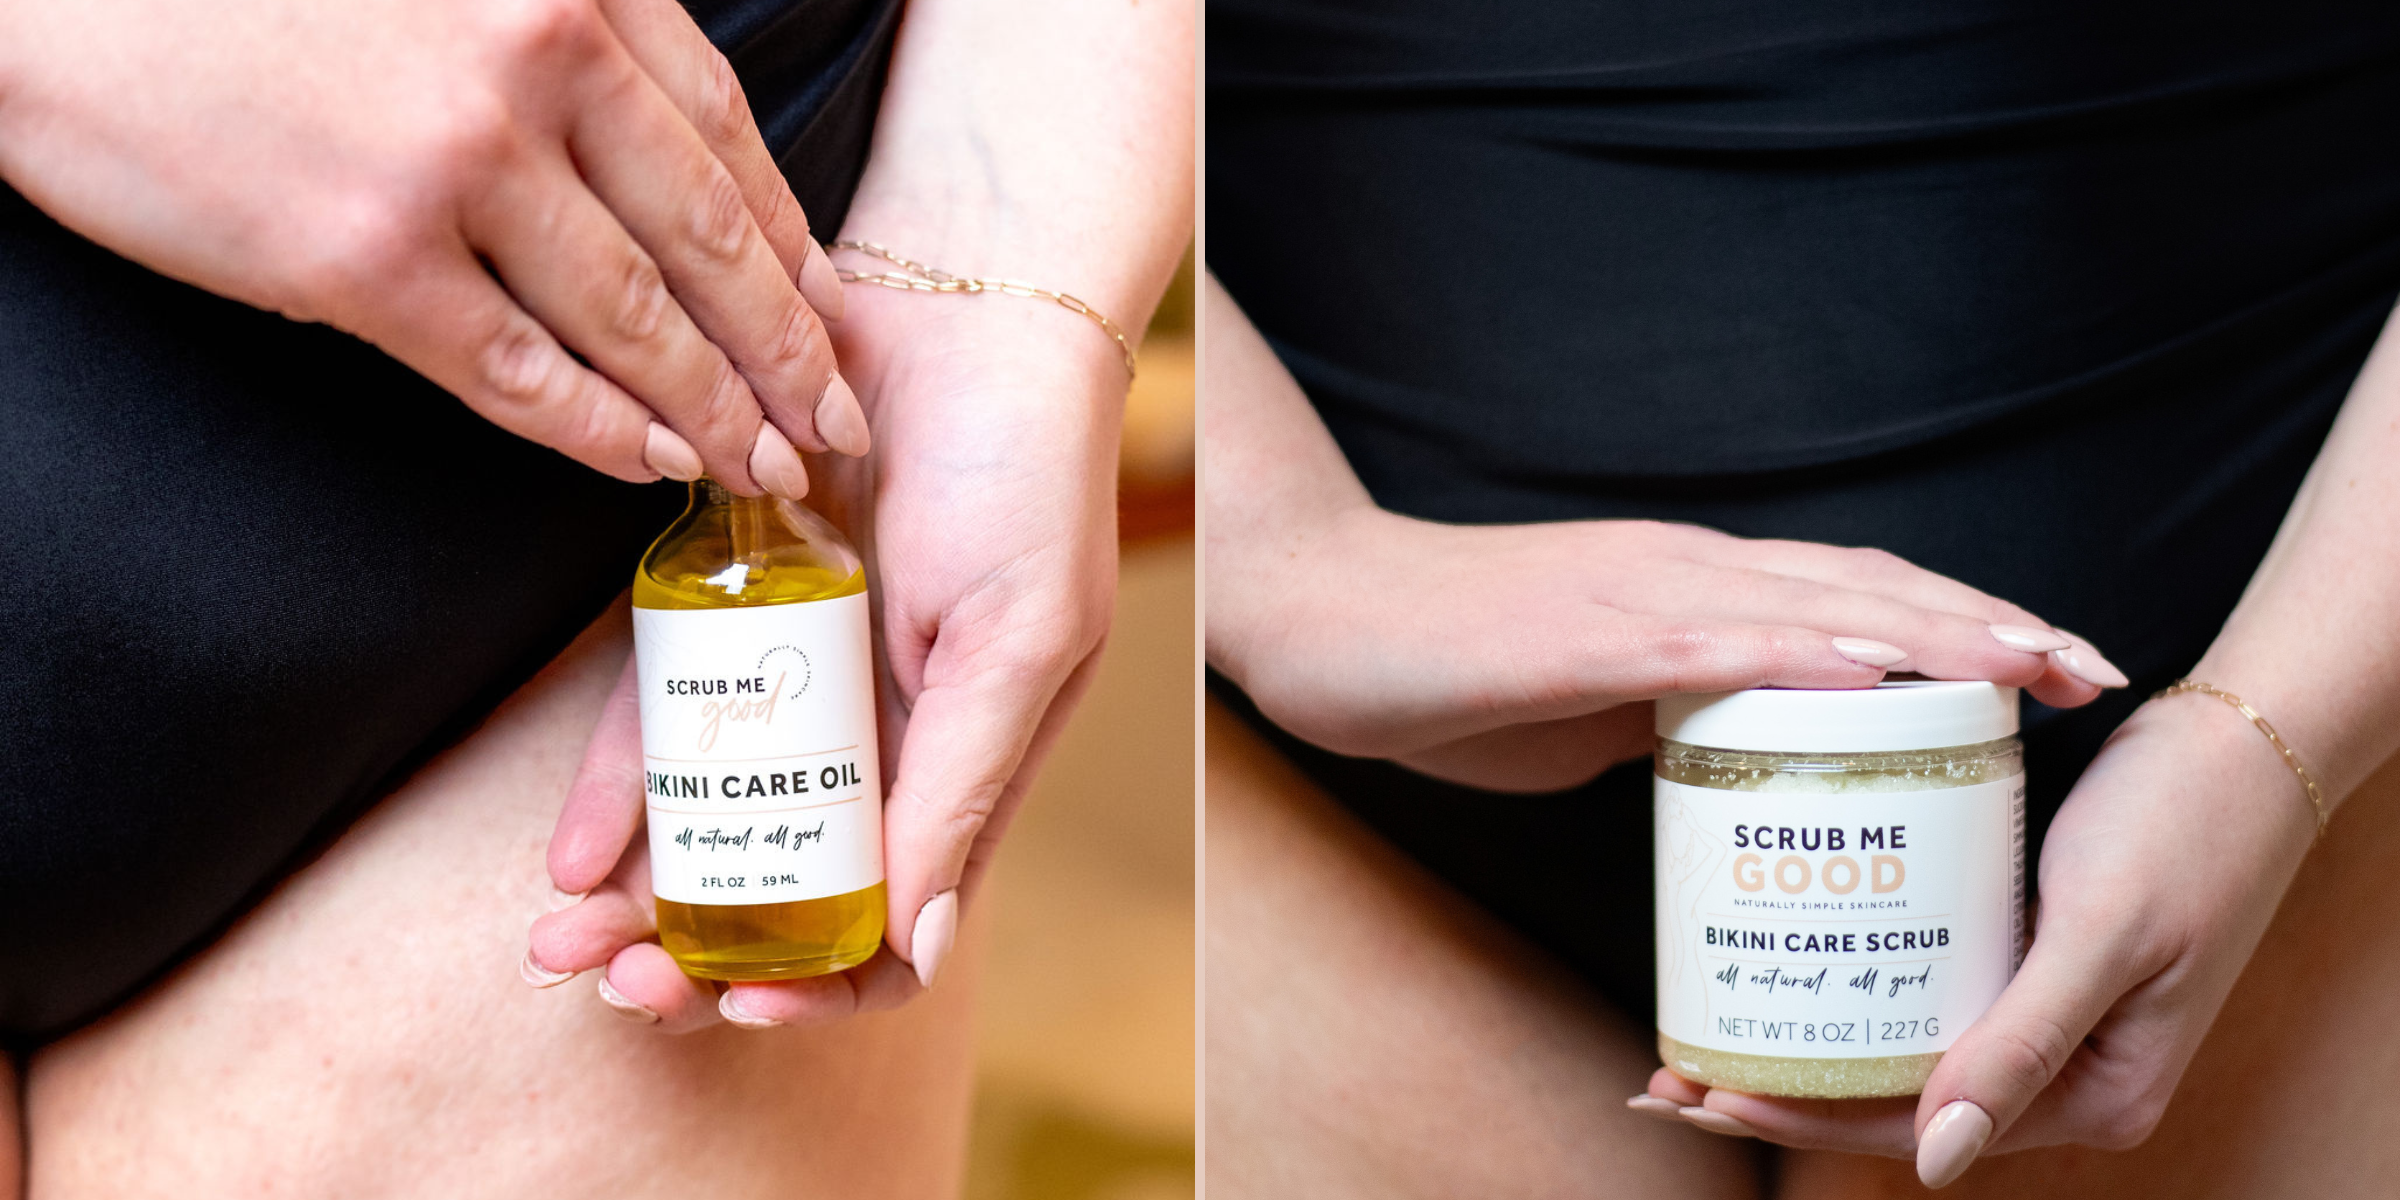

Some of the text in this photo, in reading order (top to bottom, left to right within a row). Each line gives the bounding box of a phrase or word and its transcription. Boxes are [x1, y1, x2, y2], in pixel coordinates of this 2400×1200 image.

[667, 677, 766, 695] SCRUB ME
[646, 762, 861, 799] BIKINI CARE OIL
[675, 827, 693, 851] all
[764, 824, 789, 849] all
[1734, 824, 1907, 851] SCRUB ME
[701, 874, 799, 888] 2 FL OZ 59 ML
[1733, 853, 1906, 895] GOOD
[1734, 898, 1908, 910] NATURALLY SIMPLE SKINCARE
[1706, 926, 1950, 952] BIKINI CARE SCRUB
[1716, 963, 1739, 991] all
[1849, 966, 1878, 995] all
[1718, 1016, 1939, 1042] NET WT 8 OZ 227 G
